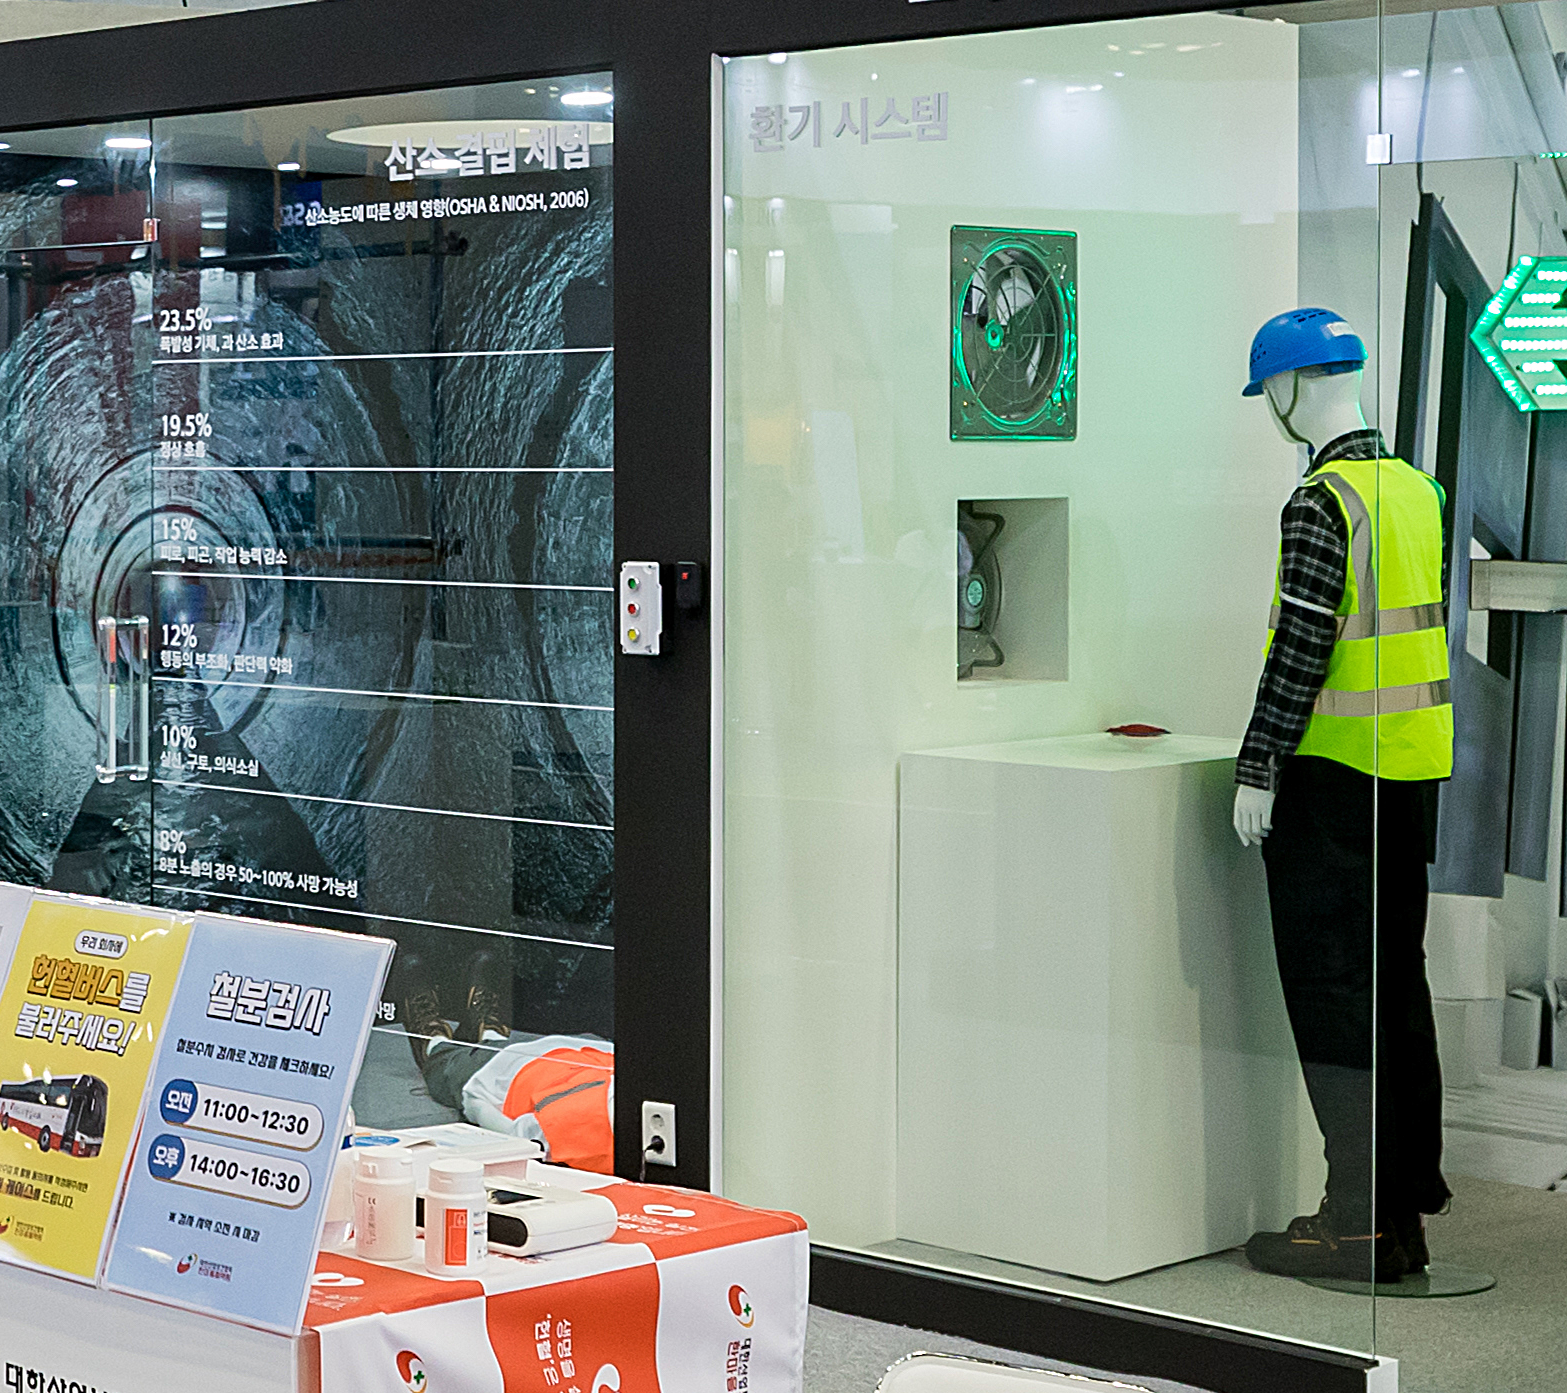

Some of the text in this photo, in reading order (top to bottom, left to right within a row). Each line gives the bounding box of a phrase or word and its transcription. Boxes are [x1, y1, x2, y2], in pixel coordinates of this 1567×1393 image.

[748, 91, 949, 153] 환기 시스템
[385, 123, 591, 182] 산소 결핍 체험
[305, 187, 591, 227] 산소농도에 따른 생체 영향(OSHA & NIOSH, 2006)
[159, 308, 213, 333] 23.5%
[159, 335, 193, 354] 폭발성
[194, 334, 220, 354] 기체,
[235, 333, 259, 351] 산소
[260, 332, 284, 351] 효과
[161, 412, 213, 437] 19.5%
[159, 440, 206, 459] 정상 호흡
[161, 518, 197, 542] 15%
[159, 545, 288, 566] 피로, 피곤, 작업 능력 감소
[161, 623, 198, 648] 12%
[160, 651, 293, 675] 행동의 부조화, 판단력 약화
[161, 724, 197, 750] 10%
[187, 753, 213, 773] 구토,
[214, 756, 260, 777] 의식소실
[158, 829, 187, 854] 8%
[158, 857, 359, 899] 8분 노출의 경우 50~100% 사망 가능성
[80, 934, 124, 955] 우리 회사에
[26, 954, 152, 1014] 헌혈버스를
[206, 971, 332, 1037] 철분검사
[14, 1002, 136, 1057] 불러주세요!
[176, 1038, 335, 1081] 철분수치 검사로 건강을 체크하세요!
[165, 1089, 310, 1136] 오전 11:00~12:30
[153, 1146, 301, 1194] 오후 14:00~16:30
[42, 1189, 74, 1210] 드립니다.
[178, 1213, 194, 1228] 검사
[242, 1227, 261, 1243] 마감
[556, 1318, 574, 1379] 생명을
